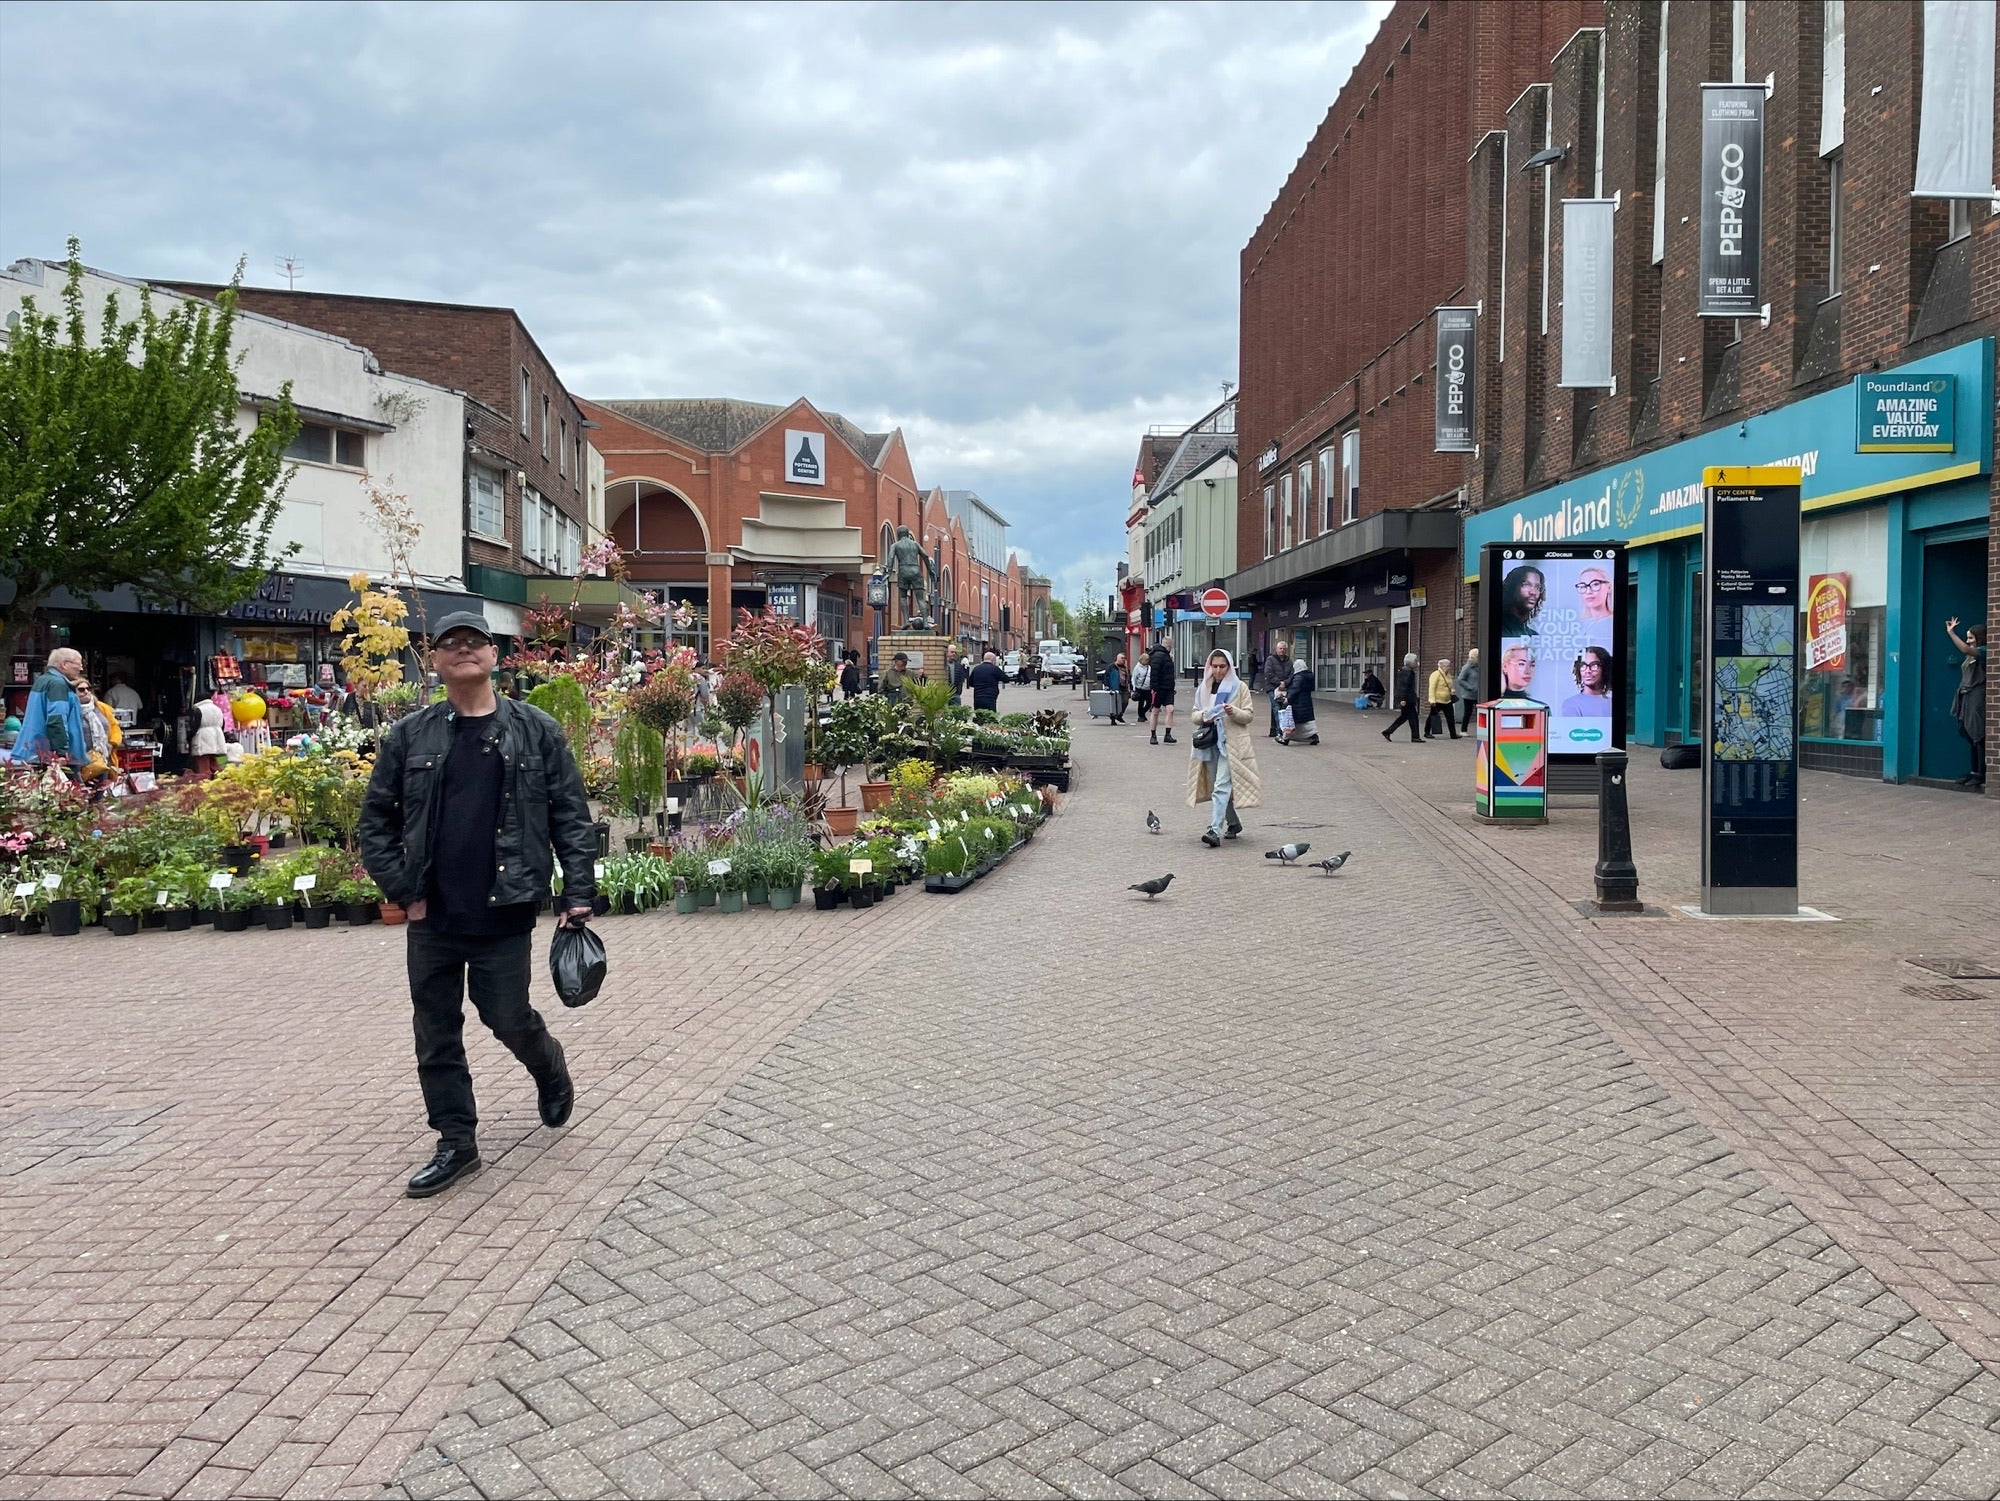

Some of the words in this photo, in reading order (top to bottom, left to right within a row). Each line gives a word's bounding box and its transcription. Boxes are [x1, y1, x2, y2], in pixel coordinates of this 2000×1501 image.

[1711, 108, 1738, 117] CLOTHING
[1739, 108, 1755, 117] FROM
[1708, 277, 1727, 286] SPEND
[1727, 277, 1732, 286] A
[1716, 286, 1727, 294] GET
[1727, 286, 1732, 294] A
[1866, 381, 1930, 392] Poundland
[1876, 398, 1938, 412] AMAZING
[1886, 411, 1927, 425] VALUE
[1872, 424, 1939, 438] EVERYDAY
[794, 462, 818, 470] POTTERIES
[1513, 485, 1611, 542] Poundland
[773, 595, 797, 605] SALE
[1815, 589, 1838, 606] MEGA
[1538, 608, 1577, 622] FIND
[1817, 606, 1841, 623] SALE
[1534, 621, 1582, 635] YOUR
[1520, 634, 1593, 648] PERFECT
[1826, 637, 1842, 649] AND
[1527, 647, 1586, 661] MATCH
[1812, 644, 1827, 664] £5
